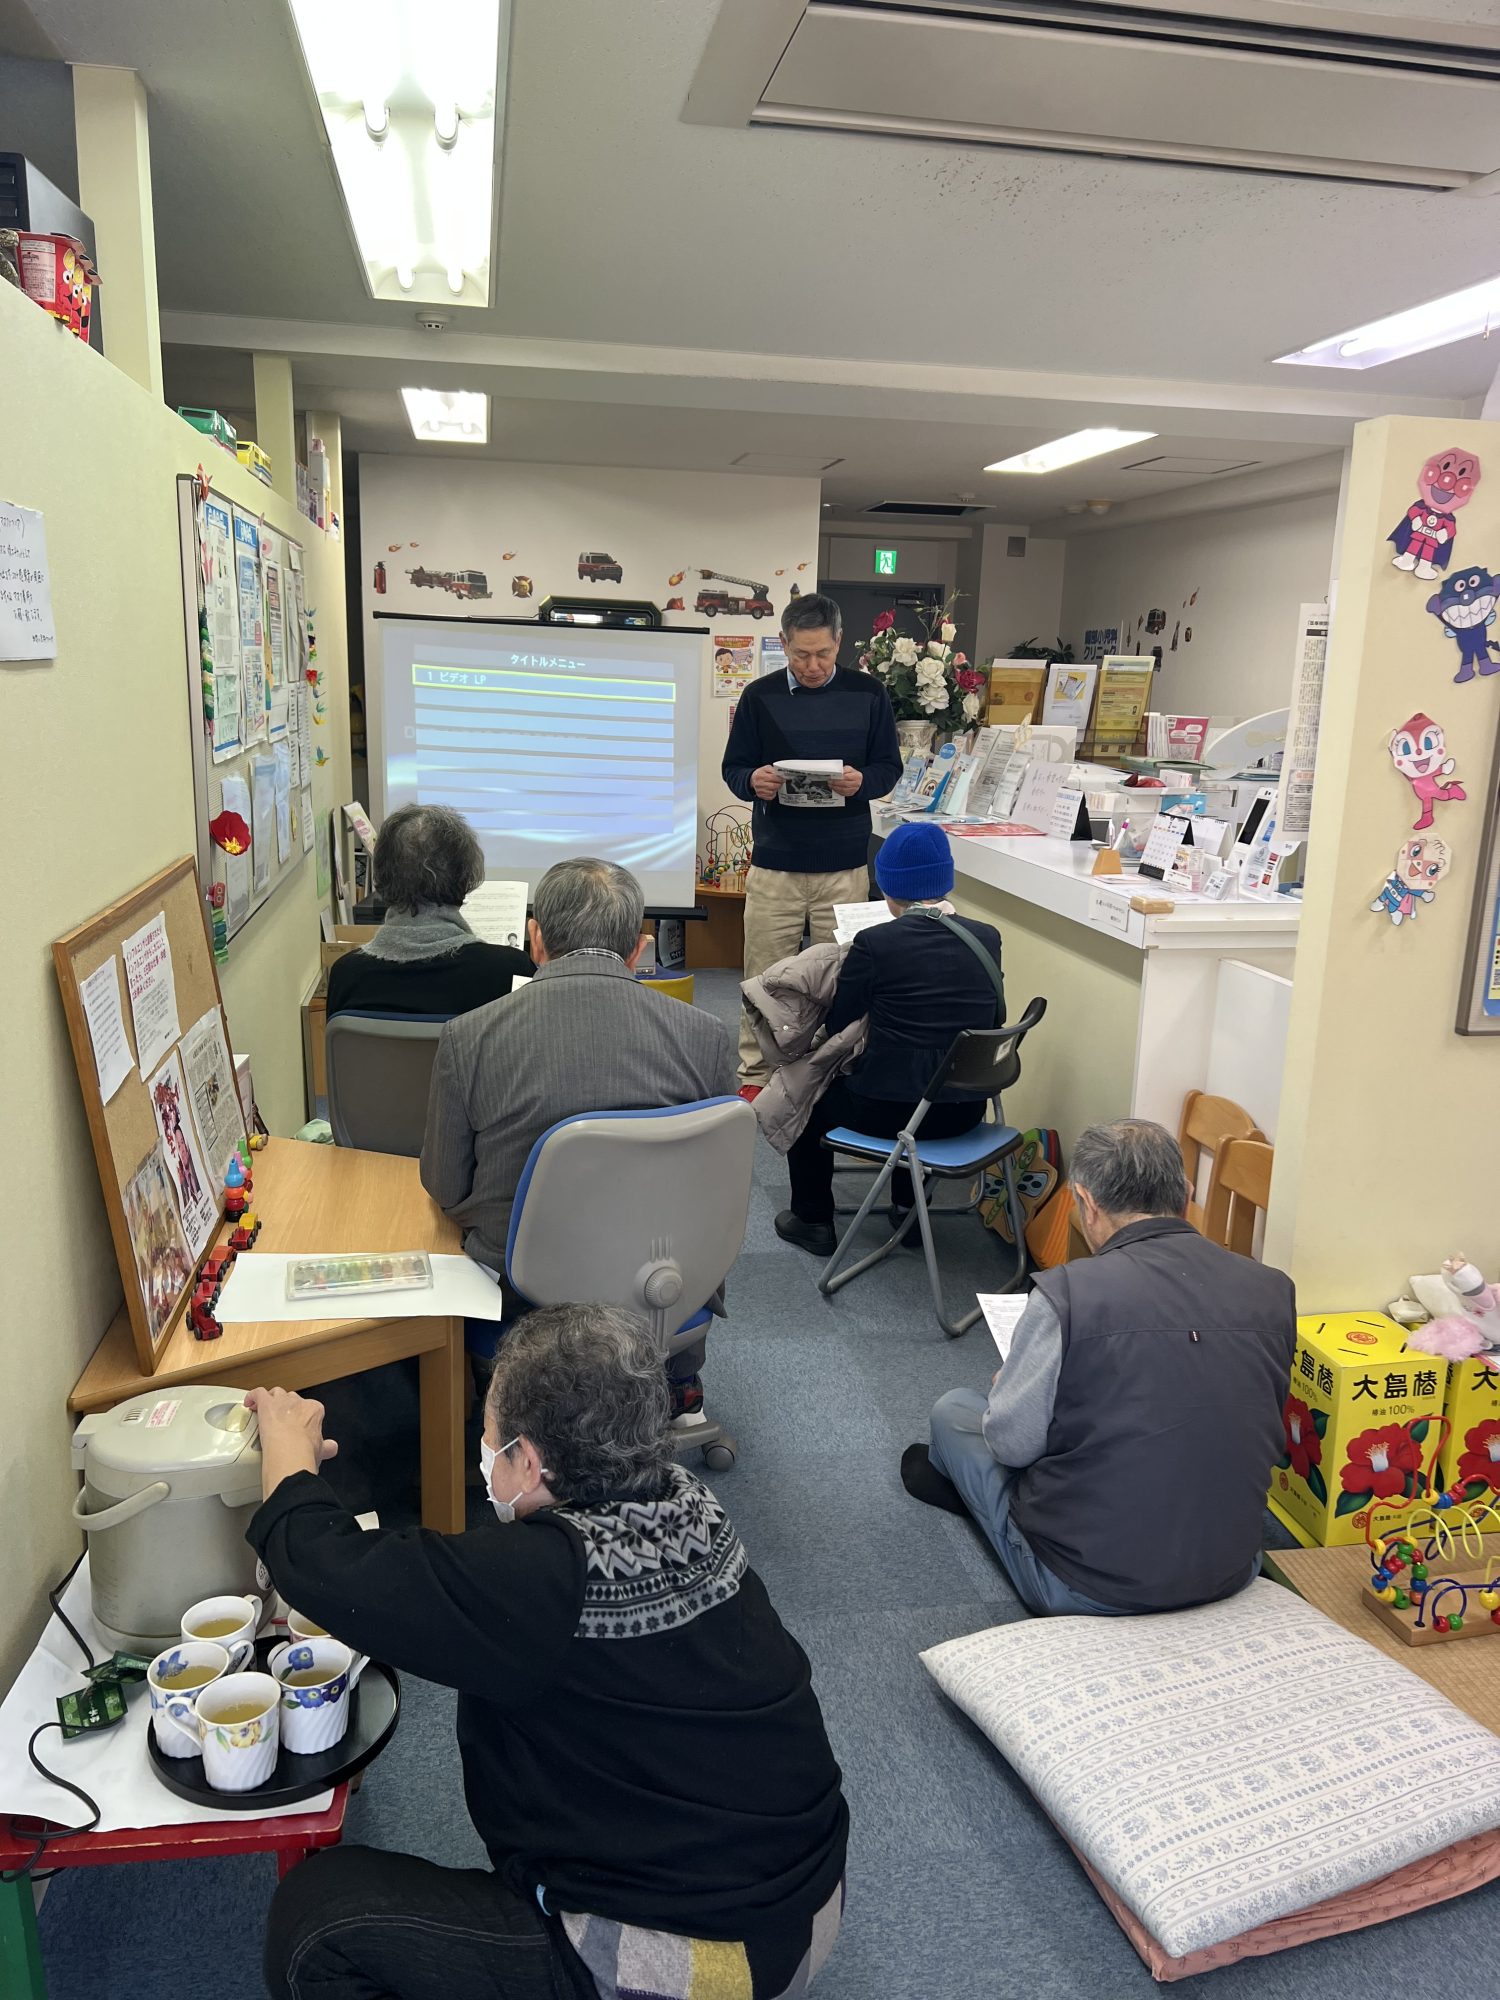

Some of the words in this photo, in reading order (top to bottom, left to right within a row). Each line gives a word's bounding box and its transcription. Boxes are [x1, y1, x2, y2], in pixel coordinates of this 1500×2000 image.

[510, 654, 586, 669] タイトルメニュー
[427, 671, 433, 681] 1
[440, 671, 469, 684] ビデオ
[474, 674, 487, 685] LP
[1351, 1369, 1438, 1401] 大島椿
[1388, 1404, 1415, 1416] 100%
